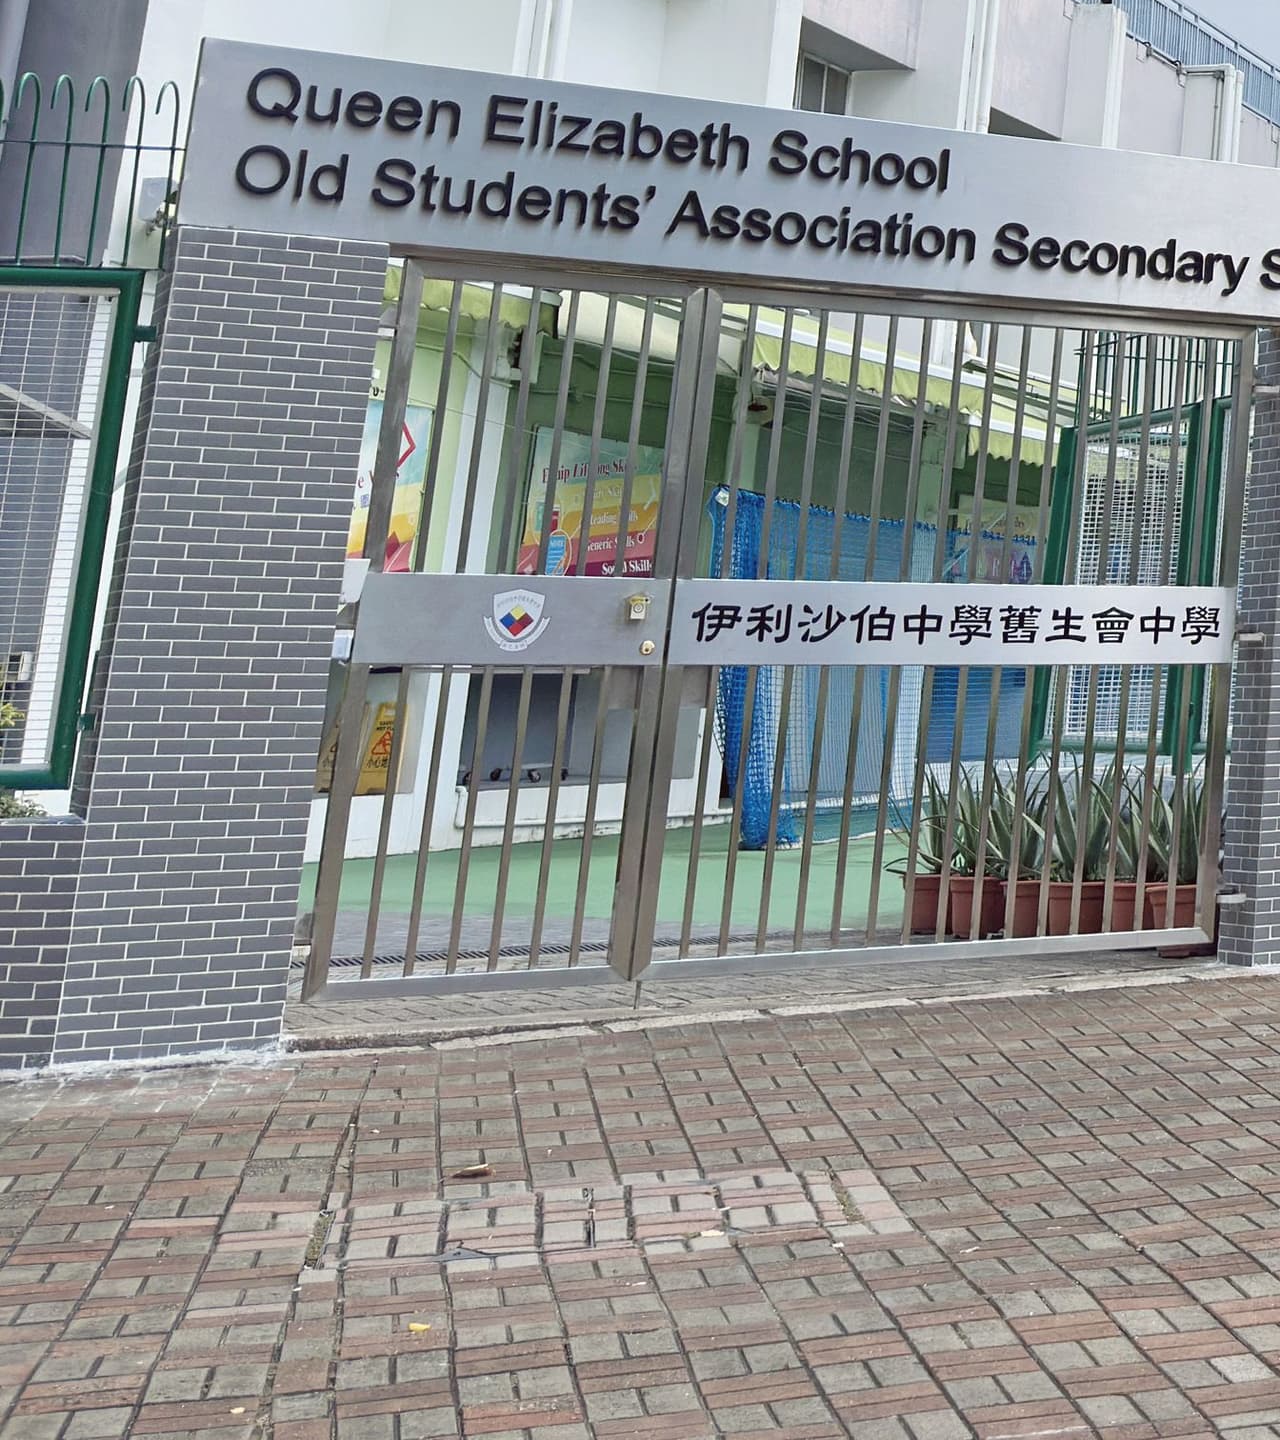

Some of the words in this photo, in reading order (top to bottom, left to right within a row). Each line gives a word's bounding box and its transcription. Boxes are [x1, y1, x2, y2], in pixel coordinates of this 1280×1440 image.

[245, 67, 462, 139] Queen
[484, 94, 750, 172] Elizabeth
[768, 130, 950, 194] School
[233, 144, 349, 205] Old
[369, 158, 658, 231] Students'
[665, 189, 978, 265] Association
[992, 223, 1251, 298] Secondary
[691, 602, 1220, 646] 伊利沙伯中學舊生會中學
